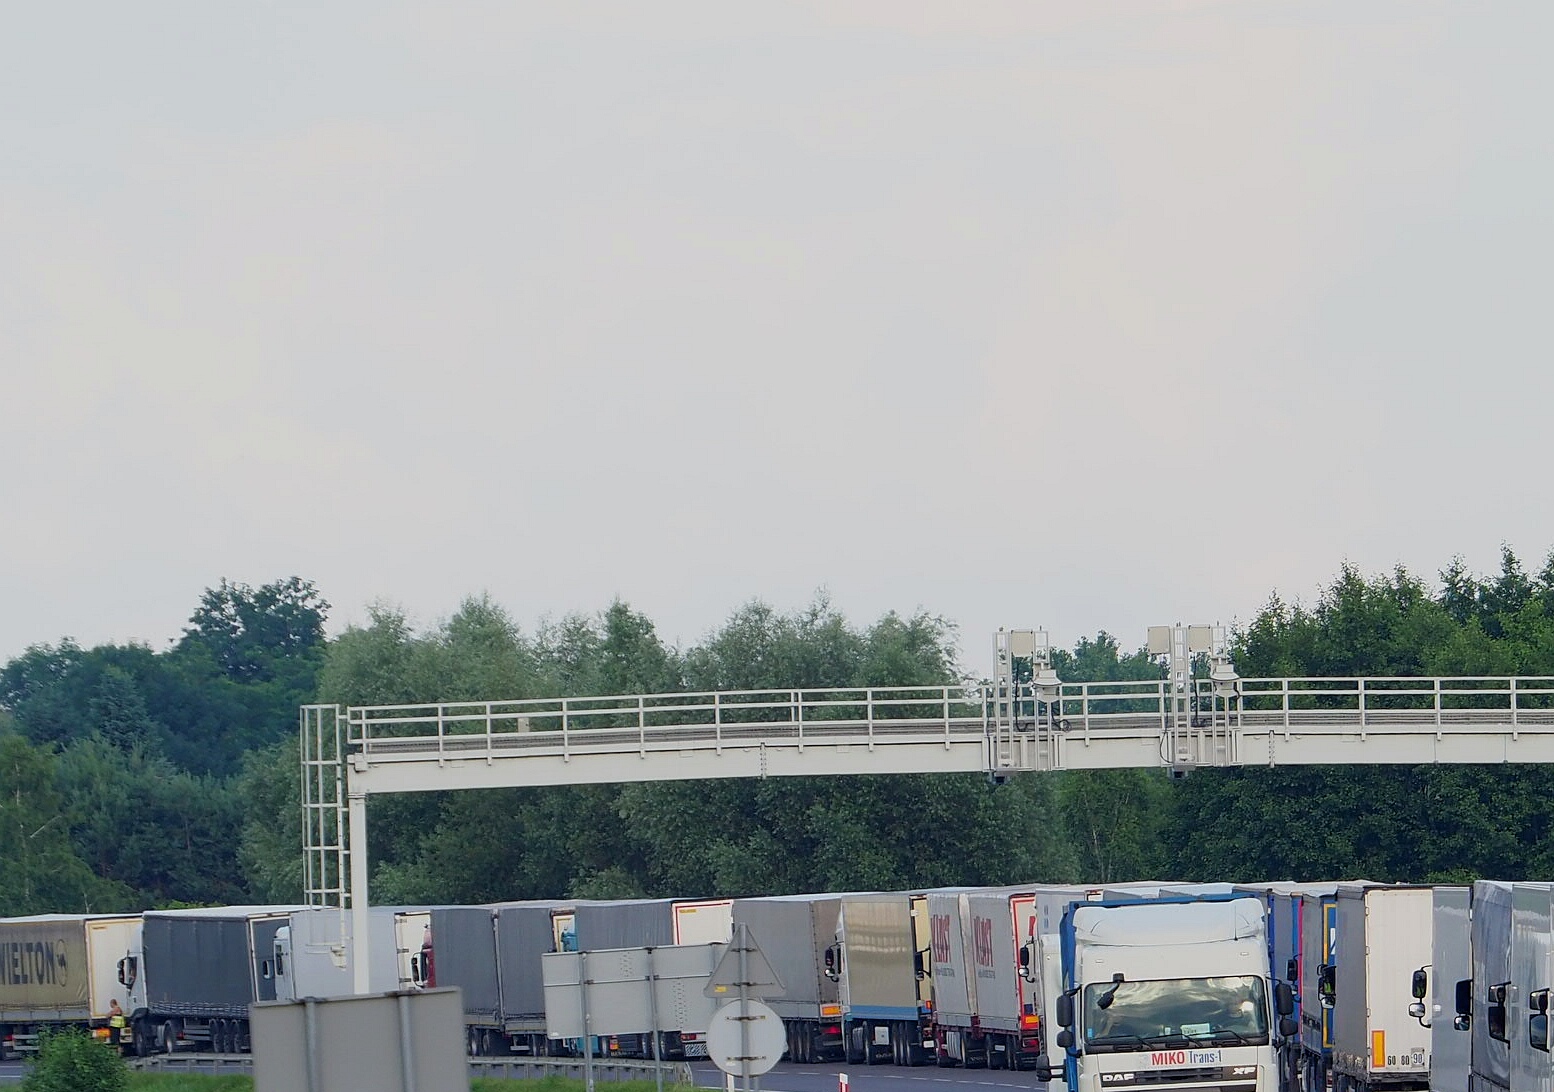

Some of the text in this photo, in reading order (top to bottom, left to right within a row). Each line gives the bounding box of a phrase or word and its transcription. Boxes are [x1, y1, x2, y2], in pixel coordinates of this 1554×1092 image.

[1151, 1050, 1222, 1066] MIKO Trans-1
[1412, 1053, 1423, 1064] 90
[1232, 1067, 1257, 1076] XF
[1102, 1073, 1135, 1082] DAF
